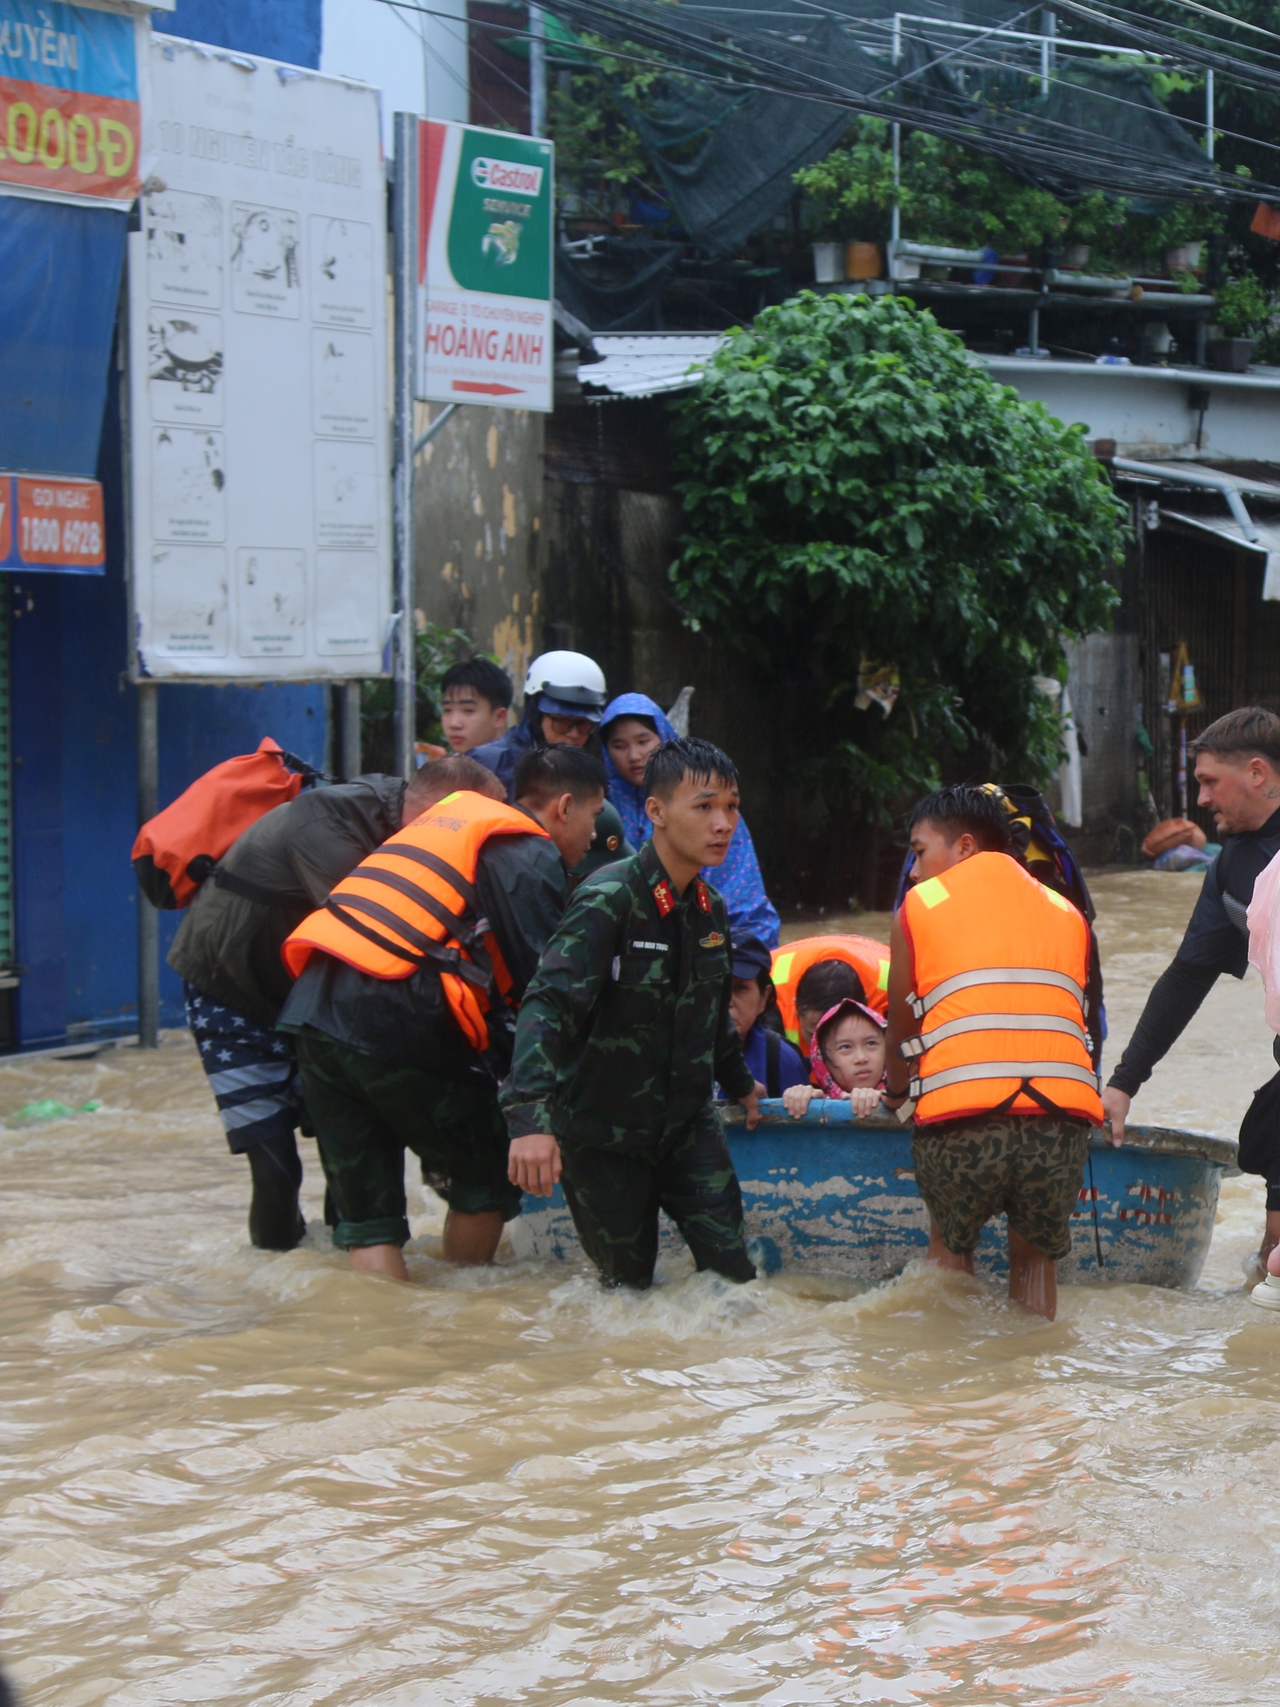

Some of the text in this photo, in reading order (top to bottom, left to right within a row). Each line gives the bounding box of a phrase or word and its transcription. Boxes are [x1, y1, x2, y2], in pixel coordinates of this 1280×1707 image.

[489, 162, 539, 192] Castrol
[483, 197, 532, 218] SERVICE
[425, 317, 544, 366] HOÀNG ANH
[21, 516, 103, 555] 1800 6928
